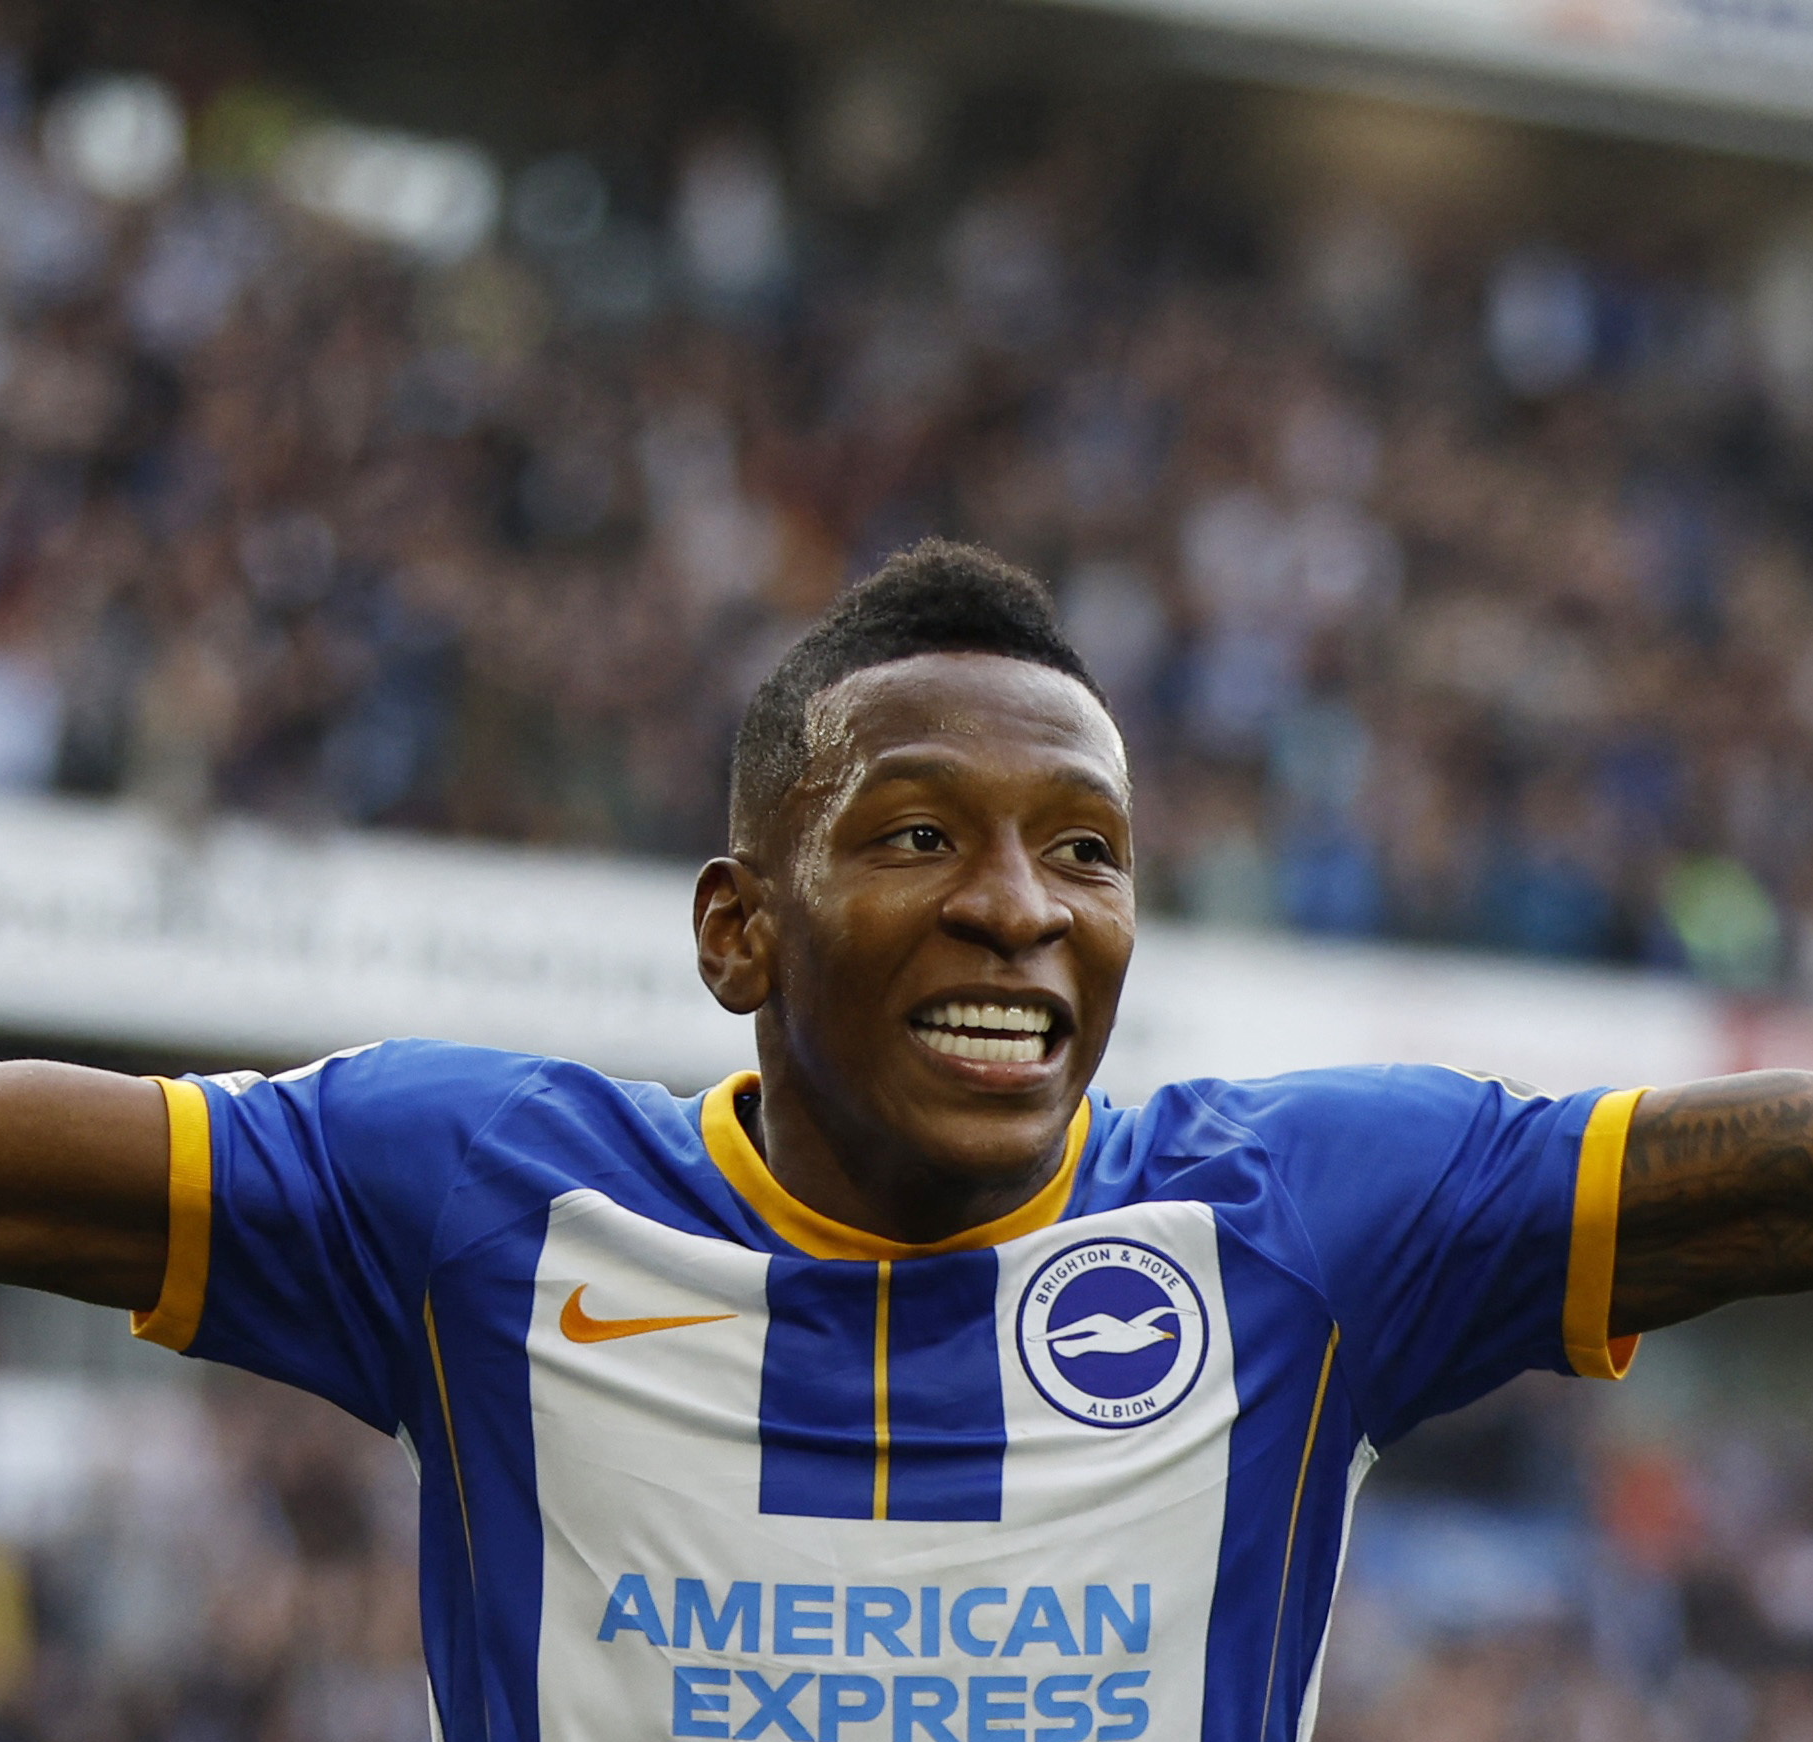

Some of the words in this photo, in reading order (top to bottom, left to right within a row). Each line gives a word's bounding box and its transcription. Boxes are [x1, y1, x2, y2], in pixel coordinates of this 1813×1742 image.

[1034, 1248, 1111, 1306] BRIGHTON
[1120, 1250, 1132, 1262] &
[1139, 1254, 1181, 1291] HOVE
[1087, 1396, 1157, 1419] ALBION
[597, 1573, 1151, 1658] AMERICAN
